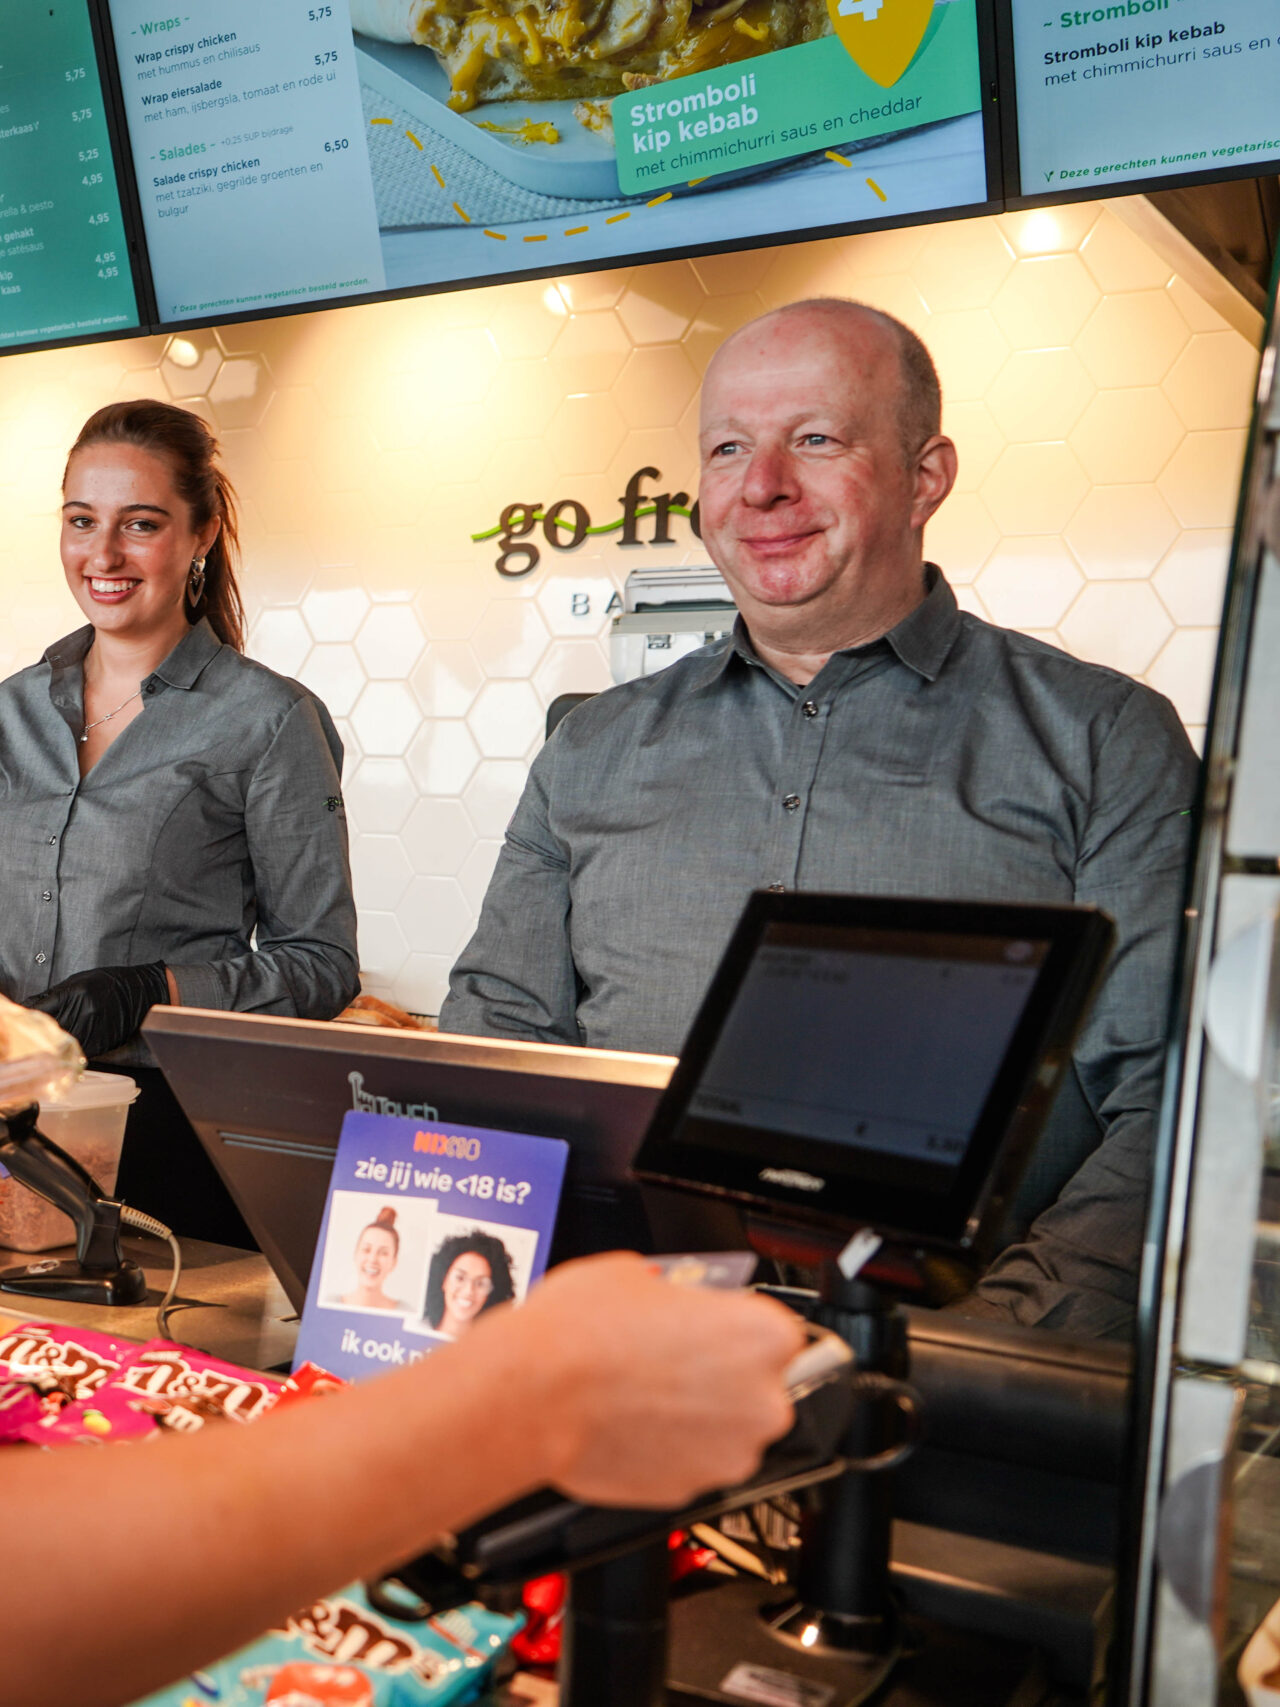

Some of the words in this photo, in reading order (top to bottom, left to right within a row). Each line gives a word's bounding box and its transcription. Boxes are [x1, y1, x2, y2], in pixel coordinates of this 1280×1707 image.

[308, 5, 333, 22] 5,75
[139, 14, 182, 37] Wraps
[134, 48, 163, 66] Wrap
[164, 40, 195, 60] crispy
[197, 30, 238, 50] chicken
[1043, 37, 1130, 65] Stromboli
[1135, 33, 1163, 50] kip
[1168, 20, 1226, 43] kebab
[137, 66, 157, 82] met
[158, 58, 202, 76] hummus
[203, 53, 217, 65] en
[218, 42, 262, 62] chilisaus
[314, 50, 339, 68] 5,75
[1044, 69, 1078, 87] met
[1082, 47, 1197, 80] chimmichurri
[1202, 40, 1243, 60] saus
[1248, 35, 1271, 51] en
[65, 68, 86, 82] 5,75
[141, 90, 169, 107] Wrap
[170, 78, 224, 100] eiersalade
[144, 109, 164, 124] met
[165, 103, 190, 120] ham,
[242, 84, 282, 101] tomaat
[282, 80, 297, 92] en
[298, 73, 324, 88] rode
[326, 68, 338, 82] ui
[629, 72, 757, 128] Stromboli
[72, 108, 93, 123] 5,75
[632, 127, 672, 154] kip
[678, 102, 760, 144] kebab
[634, 158, 665, 179] met
[669, 129, 776, 170] chimmichurri
[780, 119, 818, 143] saus
[823, 114, 844, 133] en
[848, 93, 923, 126] cheddar
[78, 148, 100, 162] 5,25
[158, 140, 208, 162] Salades
[323, 138, 350, 155] 6,50
[152, 171, 187, 188] Salade
[188, 162, 218, 183] crispy
[220, 157, 261, 177] chicken
[1059, 168, 1090, 181] Deze
[1093, 157, 1157, 177] gerechten
[1160, 149, 1207, 166] kunnen
[82, 173, 104, 187] 4,95
[155, 190, 175, 204] met
[216, 174, 259, 194] gegrilde
[260, 166, 308, 186] groenten
[310, 162, 324, 173] en
[29, 200, 55, 214] pesto
[157, 202, 191, 220] bulgur
[88, 212, 110, 227] 4,95
[4, 227, 35, 243] gehakt
[95, 251, 117, 266] 4,95
[0, 270, 14, 282] kip
[97, 266, 119, 280] 4,95
[1, 284, 22, 296] kaas
[179, 302, 198, 314] Deze
[198, 296, 236, 312] gerechten
[236, 292, 263, 305] kunnen
[264, 286, 308, 302] vegetarisch
[308, 280, 338, 294] besteld
[495, 499, 591, 577] go
[354, 1159, 389, 1182] zie
[386, 1161, 412, 1192] jij
[414, 1166, 452, 1193] wie
[456, 1174, 494, 1200] <18
[496, 1176, 531, 1206] is?
[340, 1328, 361, 1355] ik
[362, 1339, 407, 1366] ook
